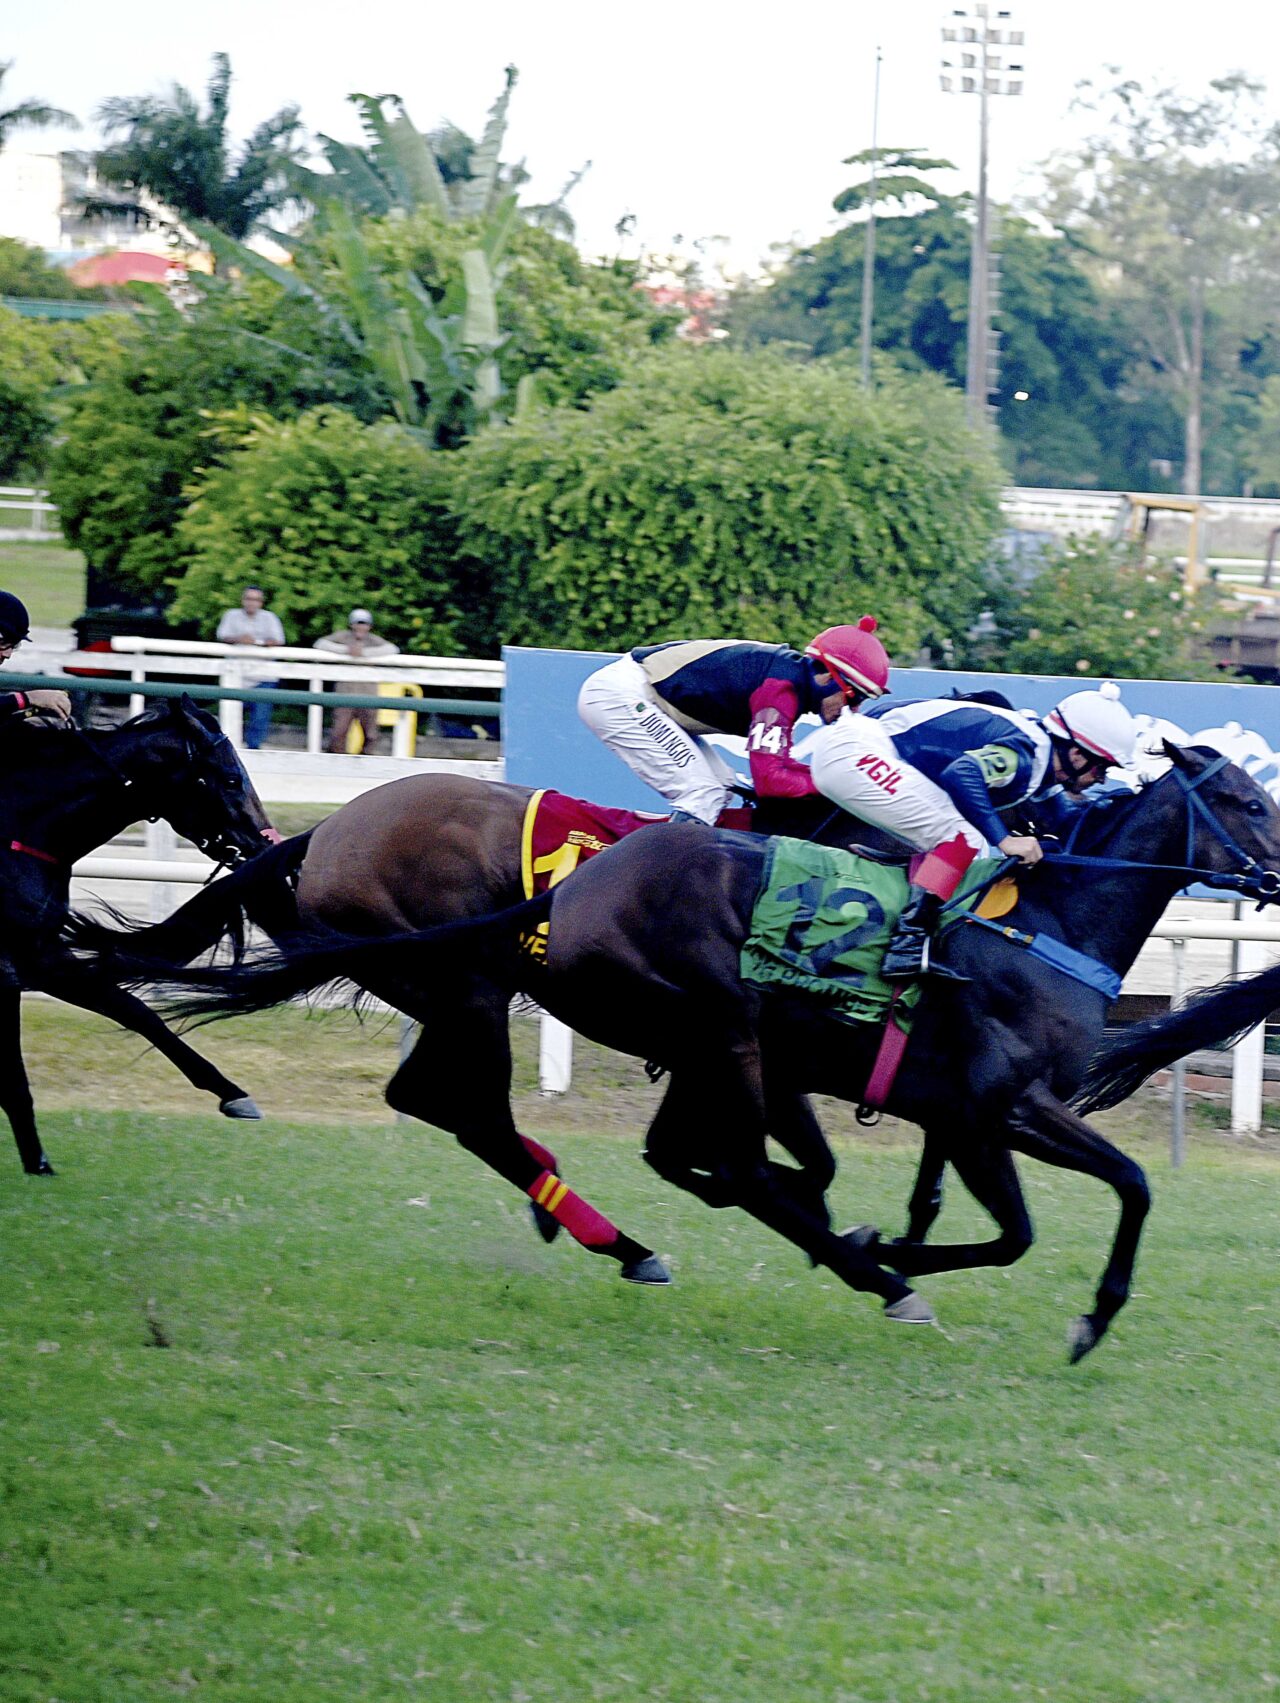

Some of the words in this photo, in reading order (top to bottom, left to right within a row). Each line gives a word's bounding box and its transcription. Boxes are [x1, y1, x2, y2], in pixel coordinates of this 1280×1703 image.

[639, 713, 696, 768] DOMINGOS
[751, 722, 782, 754] 14
[776, 877, 885, 988] 12
